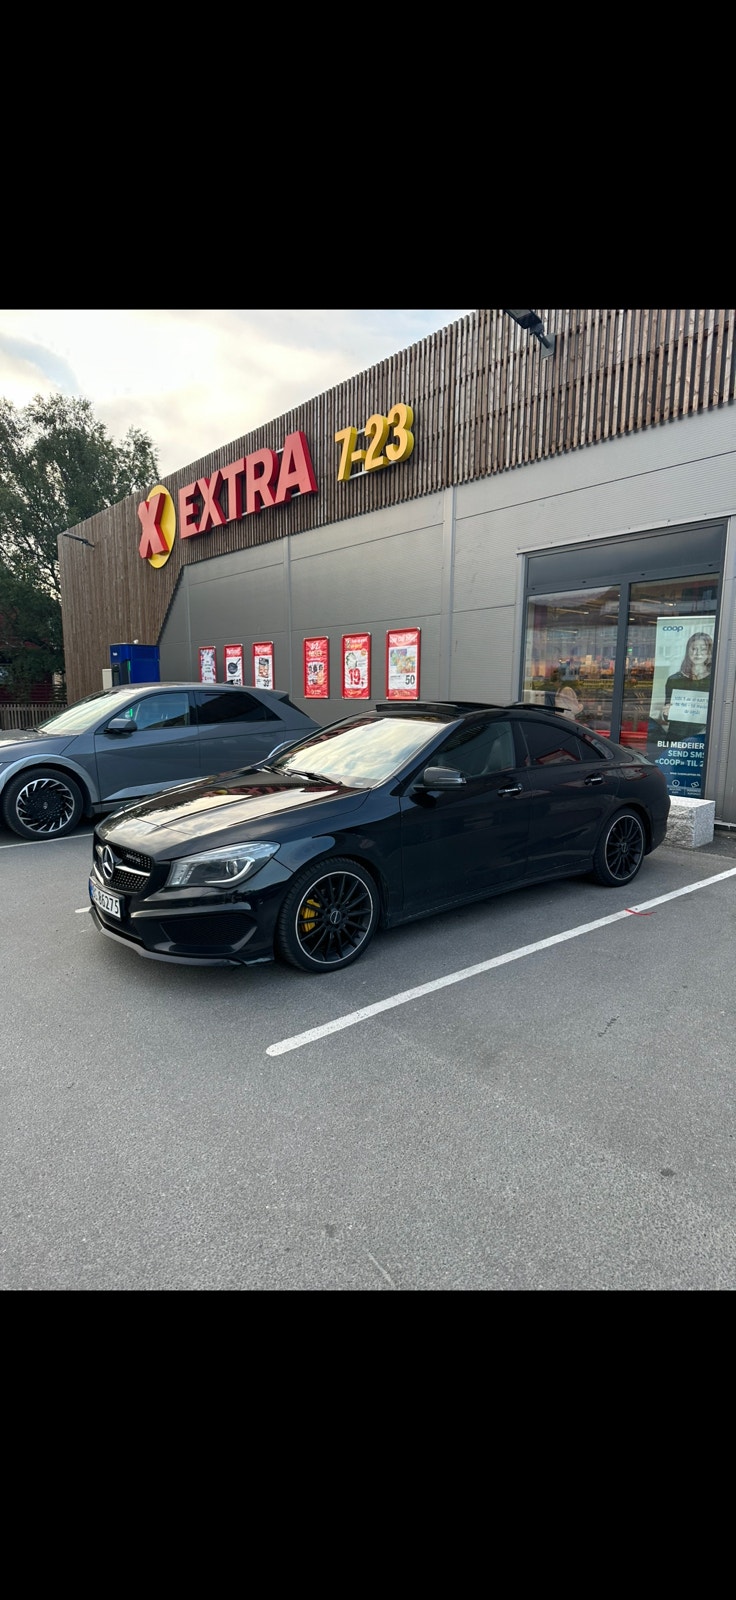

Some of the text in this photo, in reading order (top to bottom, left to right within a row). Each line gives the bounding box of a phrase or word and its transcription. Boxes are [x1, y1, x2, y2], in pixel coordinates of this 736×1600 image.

[335, 402, 415, 482] 7-23
[179, 430, 318, 539] EXTRA
[405, 674, 415, 685] 50
[657, 740, 705, 750] BLI MEDEIER
[668, 749, 688, 758] SEND
